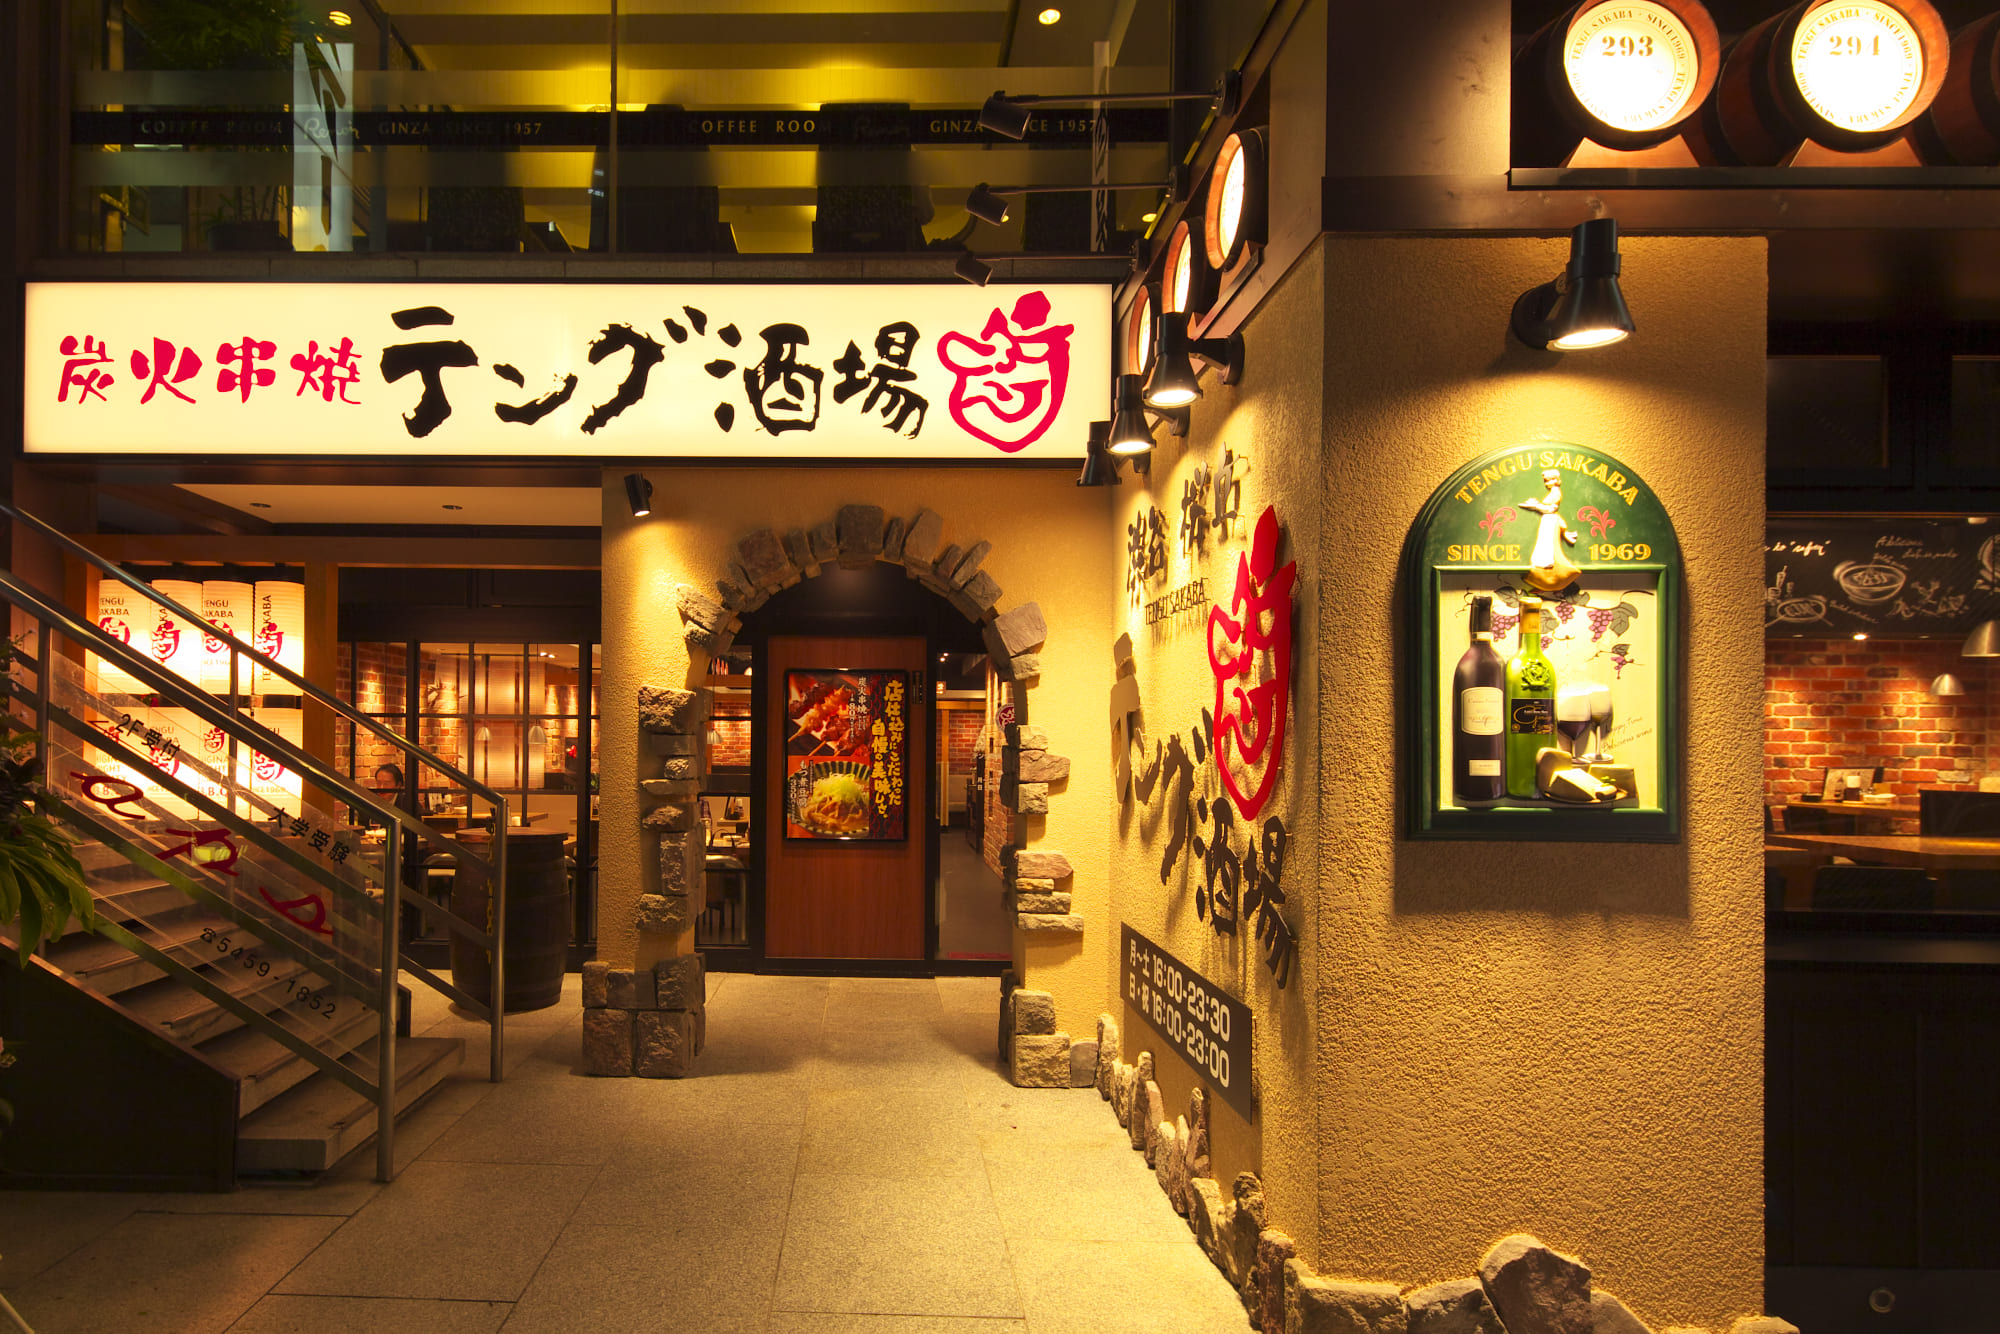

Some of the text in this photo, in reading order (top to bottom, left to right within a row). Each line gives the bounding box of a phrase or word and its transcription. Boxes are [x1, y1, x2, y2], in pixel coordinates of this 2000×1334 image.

[1601, 35, 1654, 57] 293
[377, 121, 431, 135] GINZA
[689, 120, 758, 134] COFFEE
[929, 119, 984, 134] GINZA
[57, 304, 929, 440] 炭火串焼 テング酒場
[1454, 451, 1639, 506] TENGU SAKABA
[1447, 543, 1652, 561] SINCE 1969
[1171, 577, 1207, 614] SAKABA
[857, 677, 868, 715] 炭火串焼
[115, 713, 181, 761] 2F受付
[884, 680, 904, 806] 店仕込みにこだわった
[870, 718, 892, 819] 自慢の美味しさ。
[267, 806, 350, 865] 大学受験
[1110, 632, 1292, 990] テング酒場
[1153, 954, 1231, 1043] 16:00-23:30
[1152, 990, 1230, 1089] 16:00-23:00
